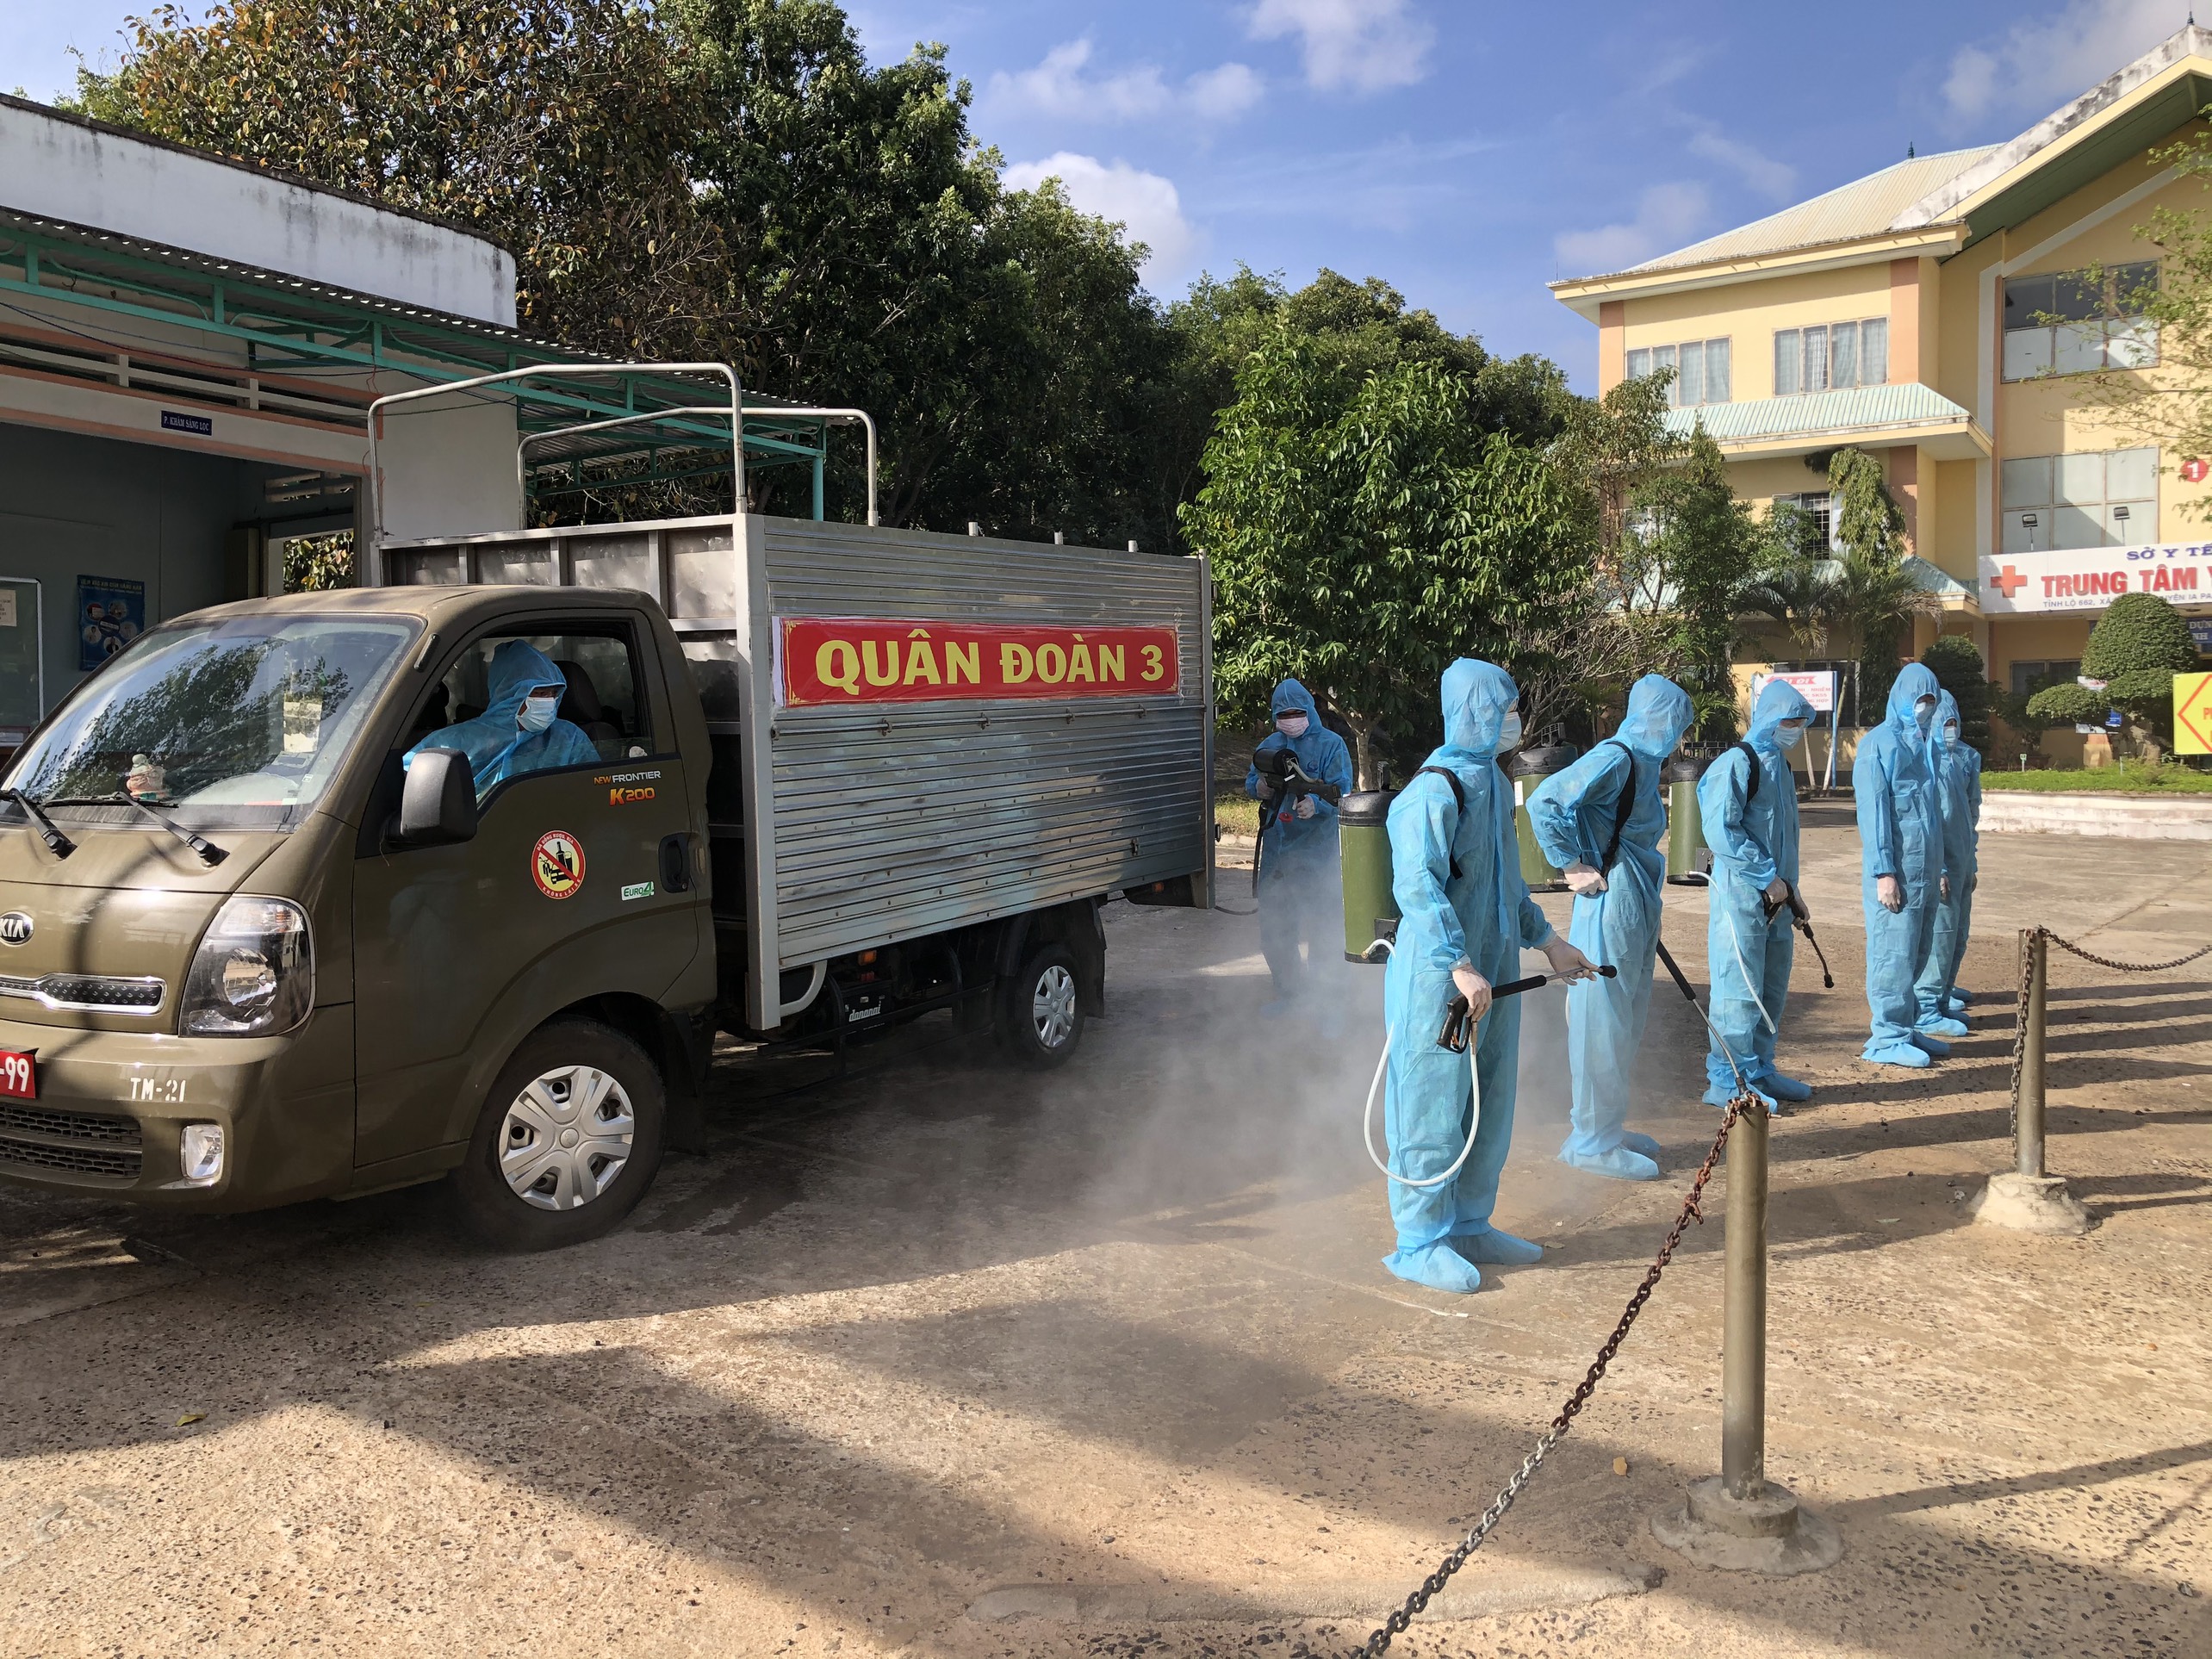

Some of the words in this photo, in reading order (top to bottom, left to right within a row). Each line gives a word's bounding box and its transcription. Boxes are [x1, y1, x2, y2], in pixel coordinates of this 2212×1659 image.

[2187, 462, 2198, 478] 1
[2127, 546, 2156, 561] SỞ
[2162, 548, 2179, 558] Y
[2041, 571, 2128, 598] TRUNG
[2139, 563, 2197, 592] TÂM
[815, 628, 980, 696] QUÂN
[999, 632, 1126, 684] ĐOÀN
[1140, 644, 1165, 681] 3
[593, 776, 612, 785] NEW
[612, 770, 662, 783] FRONTIER
[609, 787, 656, 806] K200
[0, 918, 25, 938] KIA
[130, 1078, 186, 1103] TM-21
